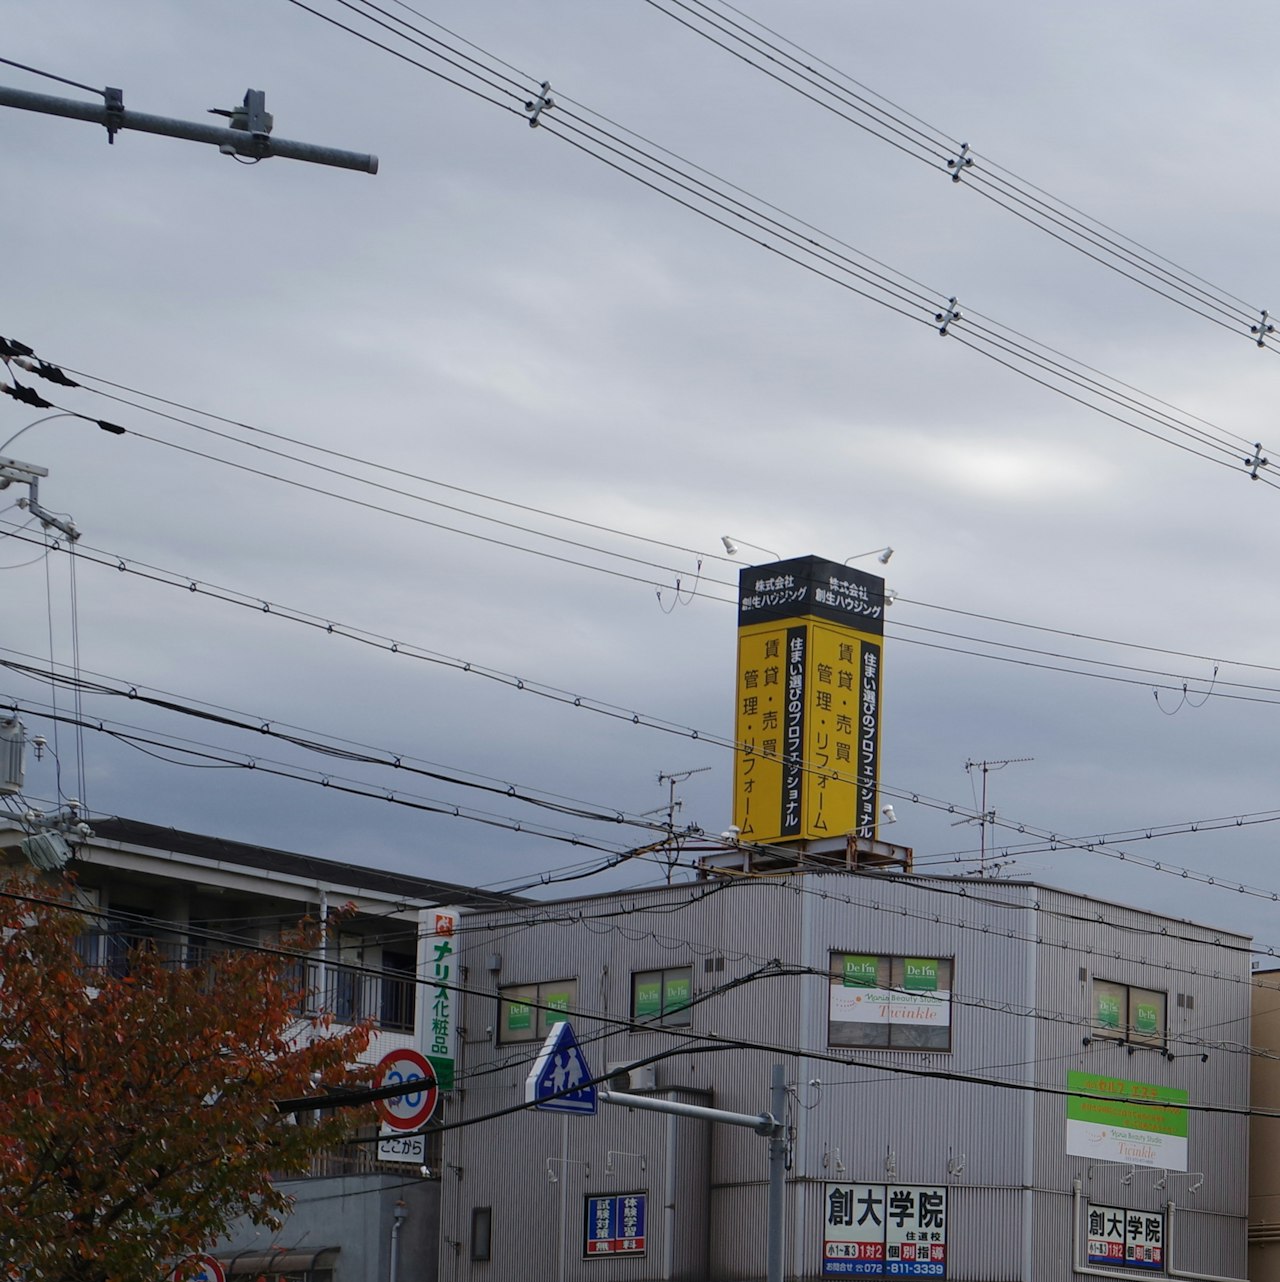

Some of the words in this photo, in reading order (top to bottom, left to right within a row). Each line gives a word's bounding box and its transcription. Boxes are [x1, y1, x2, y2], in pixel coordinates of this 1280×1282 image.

[742, 586, 807, 611] 創生ハウジング
[755, 575, 794, 592] 株式会社
[829, 577, 869, 600] 株式会社
[816, 588, 881, 618] 創生ハウジング
[761, 639, 780, 759] 賃貸・売買
[836, 642, 854, 764] 賃貸・売買
[784, 637, 804, 827] 住まい選びのプロフェッショナル
[813, 662, 833, 832] 管理・リフォーム
[859, 651, 877, 838] 住まい選びのプロフェッショナル
[740, 669, 759, 835] 管理・リフォーム
[847, 962, 860, 972] De
[907, 965, 920, 975] De
[432, 941, 453, 1055] ナリス化粧品
[879, 1004, 937, 1020] Twinkle
[828, 1187, 943, 1229] 創大学院
[905, 1231, 941, 1242] 住道校
[1089, 1209, 1160, 1243] 創大学院
[888, 1244, 944, 1260] 個別指導
